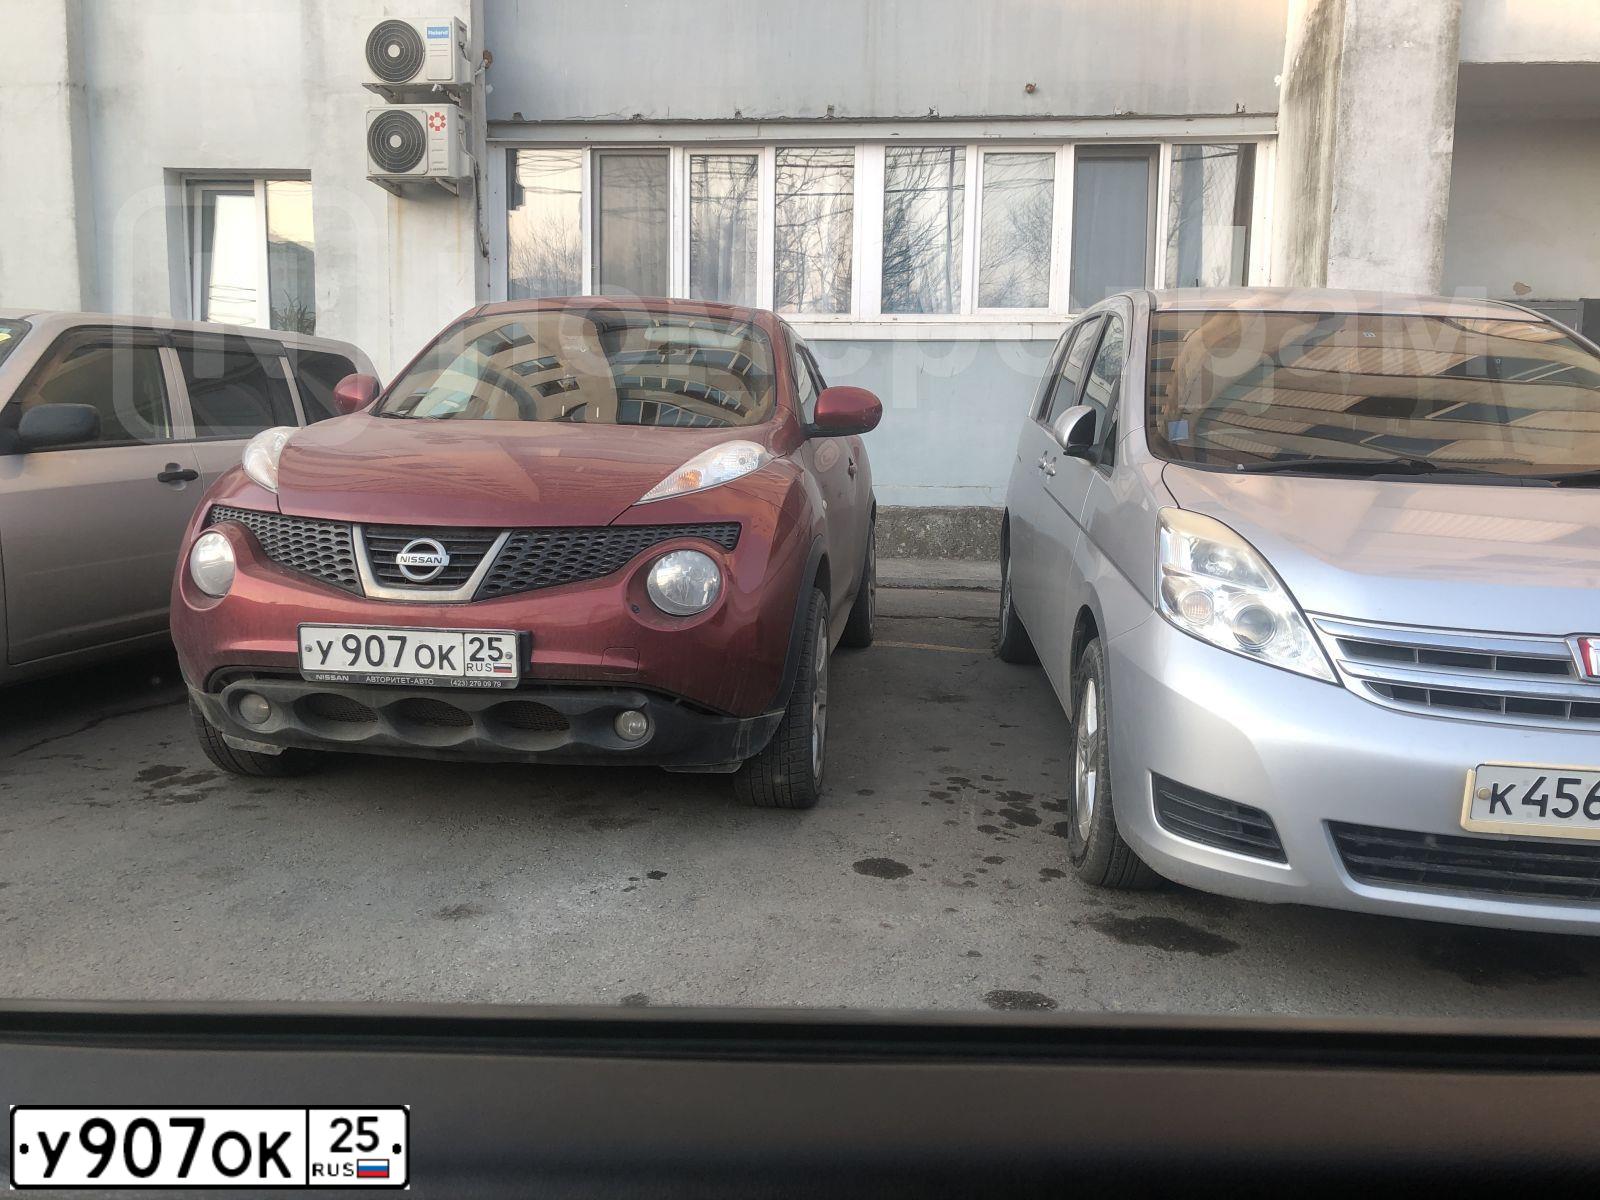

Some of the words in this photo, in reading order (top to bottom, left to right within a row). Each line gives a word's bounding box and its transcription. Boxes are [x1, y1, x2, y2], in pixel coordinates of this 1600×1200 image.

[400, 555, 443, 564] NISSAN
[468, 637, 504, 662] 25
[466, 662, 493, 672] RUS
[365, 676, 434, 686] АВТОРИТЕТ-АВТО
[450, 679, 468, 687] (423)
